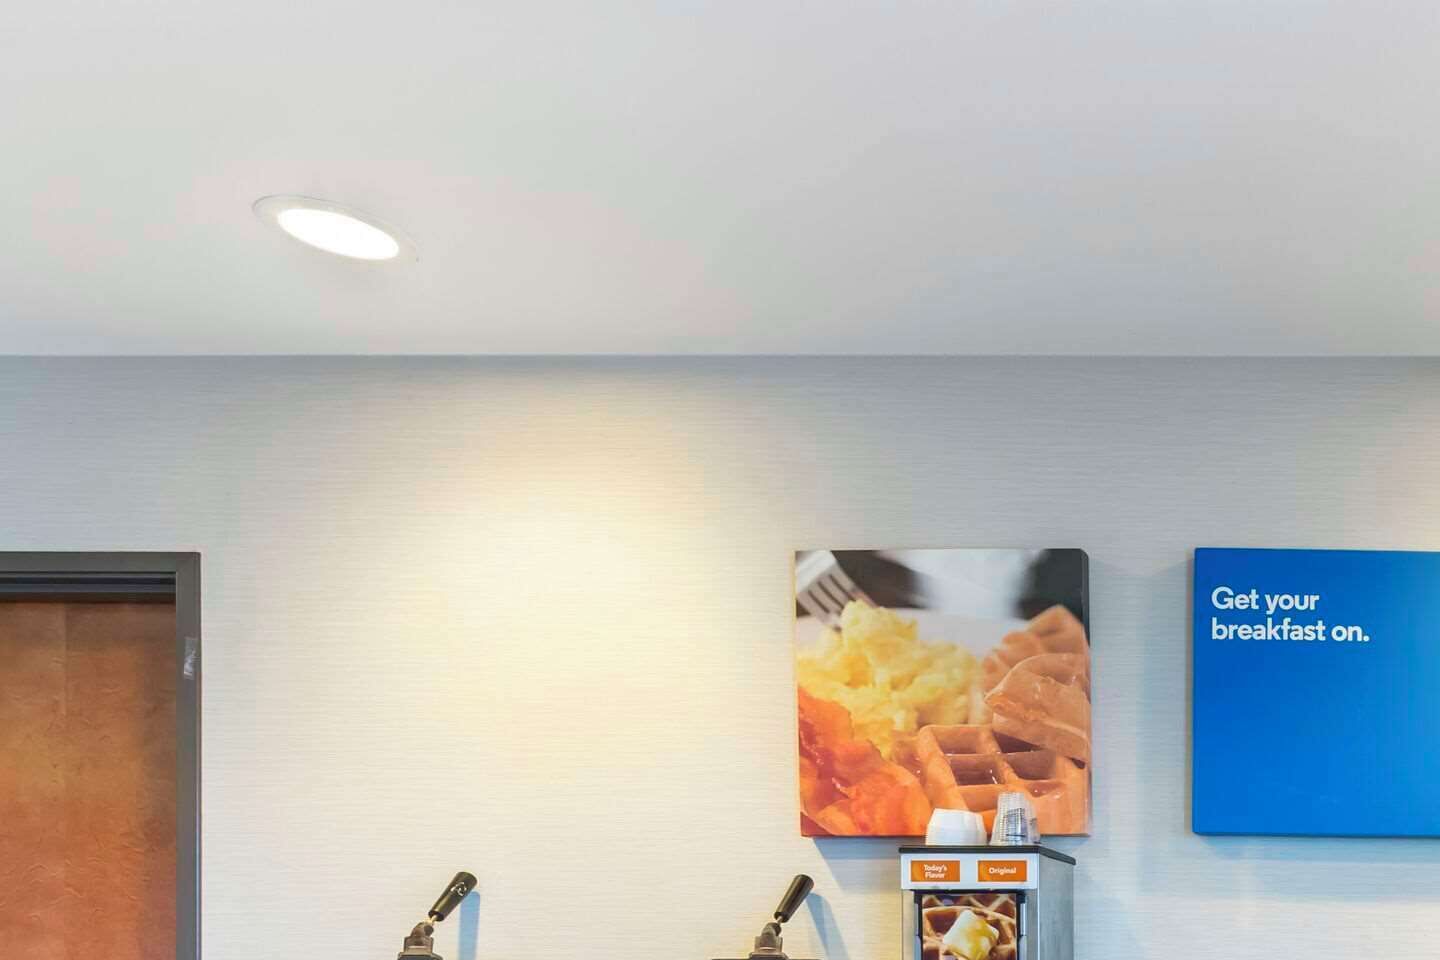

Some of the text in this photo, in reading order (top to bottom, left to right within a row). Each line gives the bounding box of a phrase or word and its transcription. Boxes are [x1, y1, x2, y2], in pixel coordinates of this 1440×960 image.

[1211, 586, 1320, 615] Get your
[1211, 617, 1370, 642] breakfast on.
[923, 864, 947, 873] Today's
[988, 867, 1017, 875] Original
